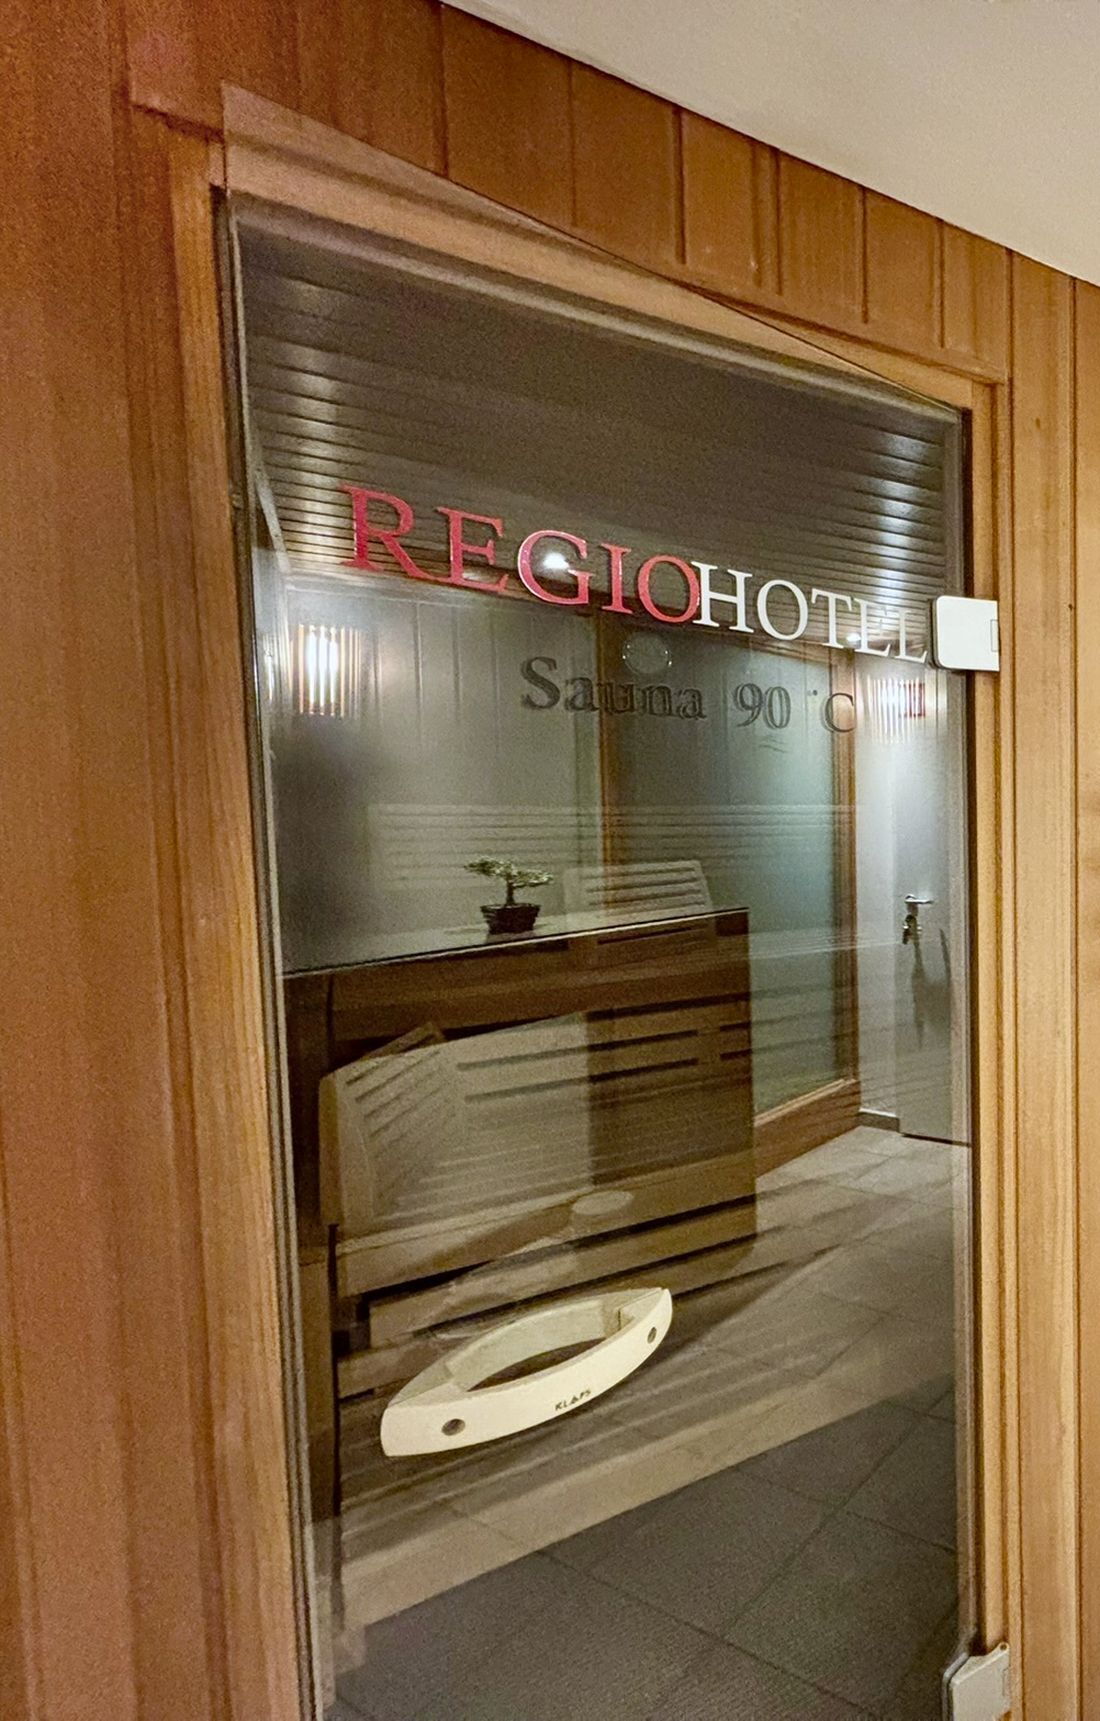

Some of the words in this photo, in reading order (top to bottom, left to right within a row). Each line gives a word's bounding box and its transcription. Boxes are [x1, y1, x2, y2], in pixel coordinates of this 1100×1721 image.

[339, 484, 928, 663] REGIOHOTEL
[520, 655, 708, 720] Sauna
[733, 682, 791, 730] 90
